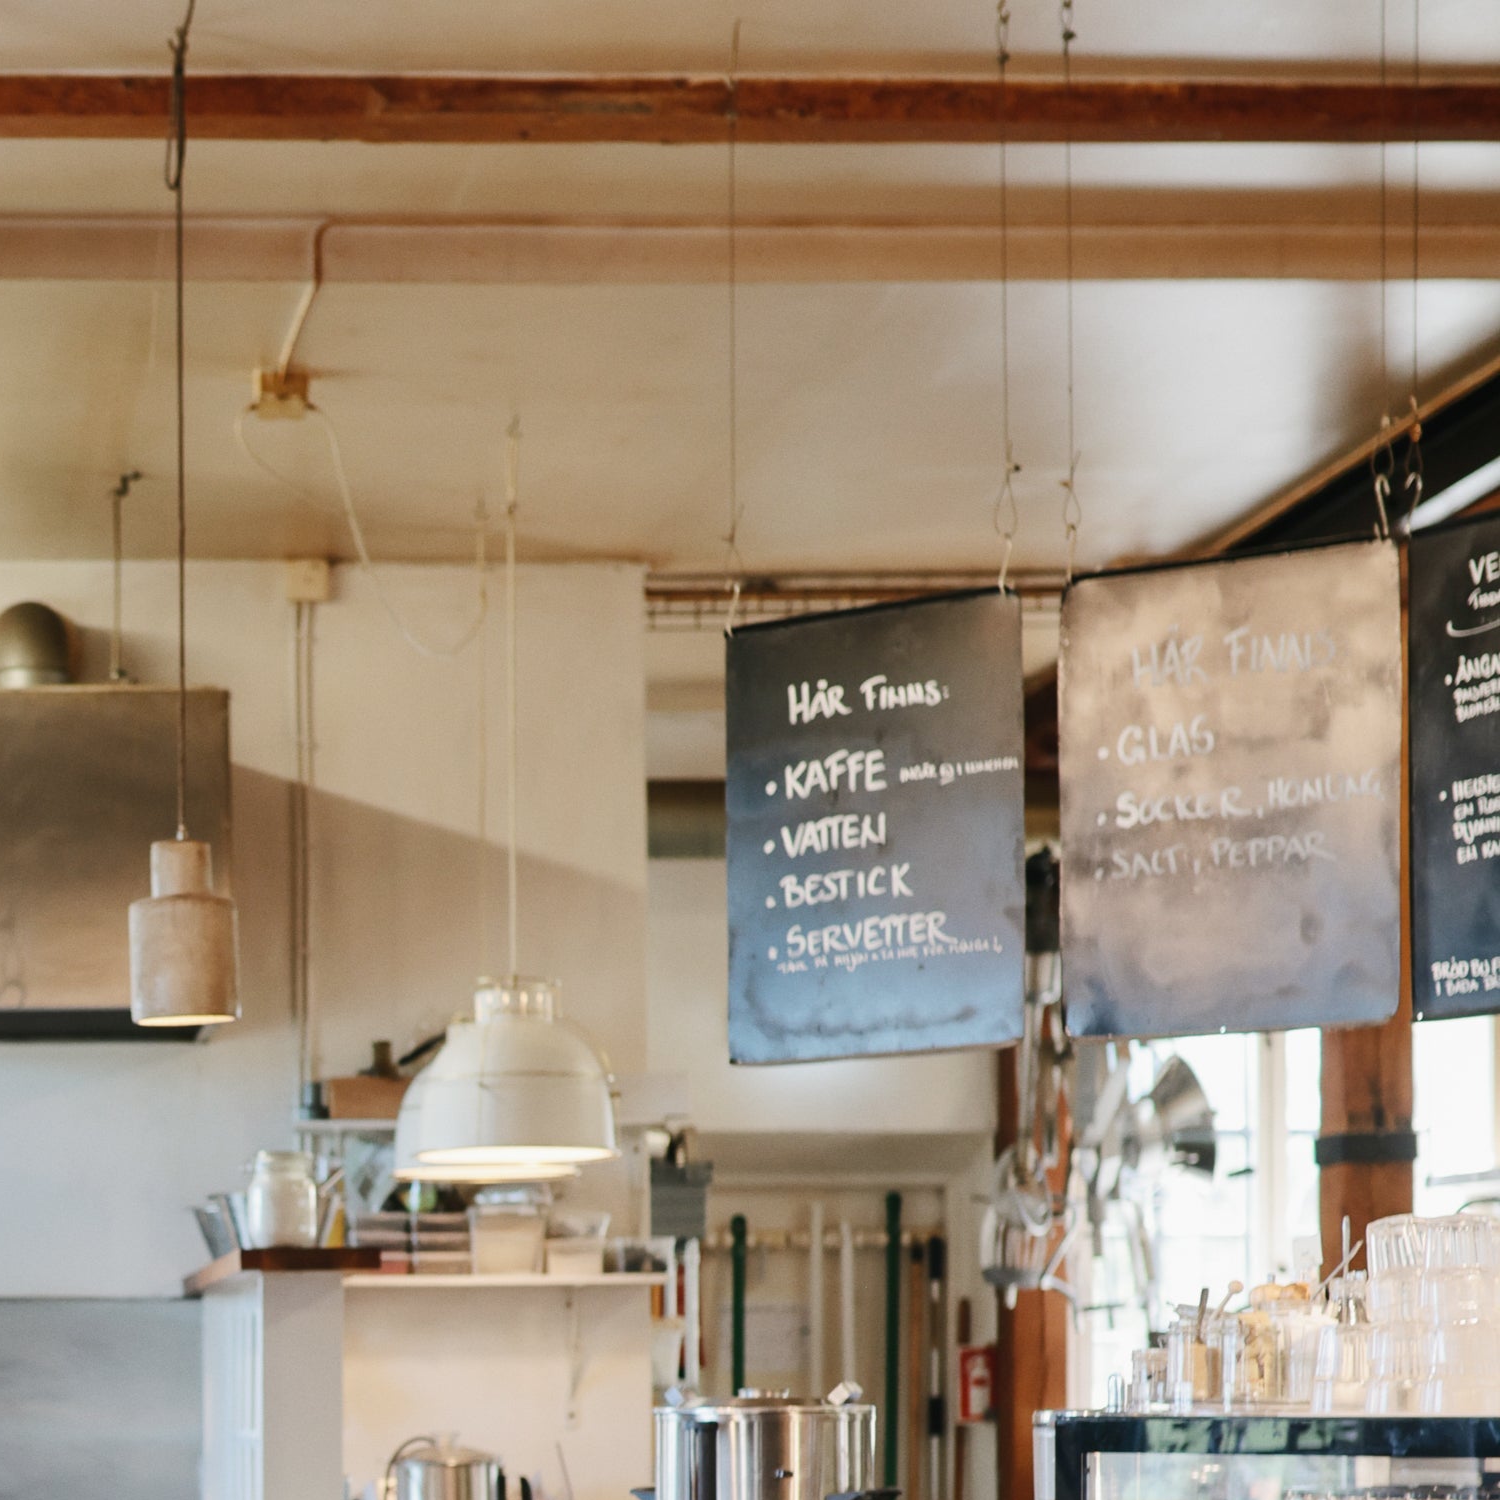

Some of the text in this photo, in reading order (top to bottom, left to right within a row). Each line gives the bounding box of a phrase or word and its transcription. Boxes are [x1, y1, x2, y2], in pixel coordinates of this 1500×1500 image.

[1468, 551, 1500, 586] VE
[1117, 714, 1215, 766] GLAS
[784, 749, 888, 799] KAFFE
[780, 811, 887, 859] VATTEN
[1211, 831, 1337, 867] PEPPAR
[779, 862, 914, 909] BESTICK
[786, 911, 958, 959] SERVETTER
